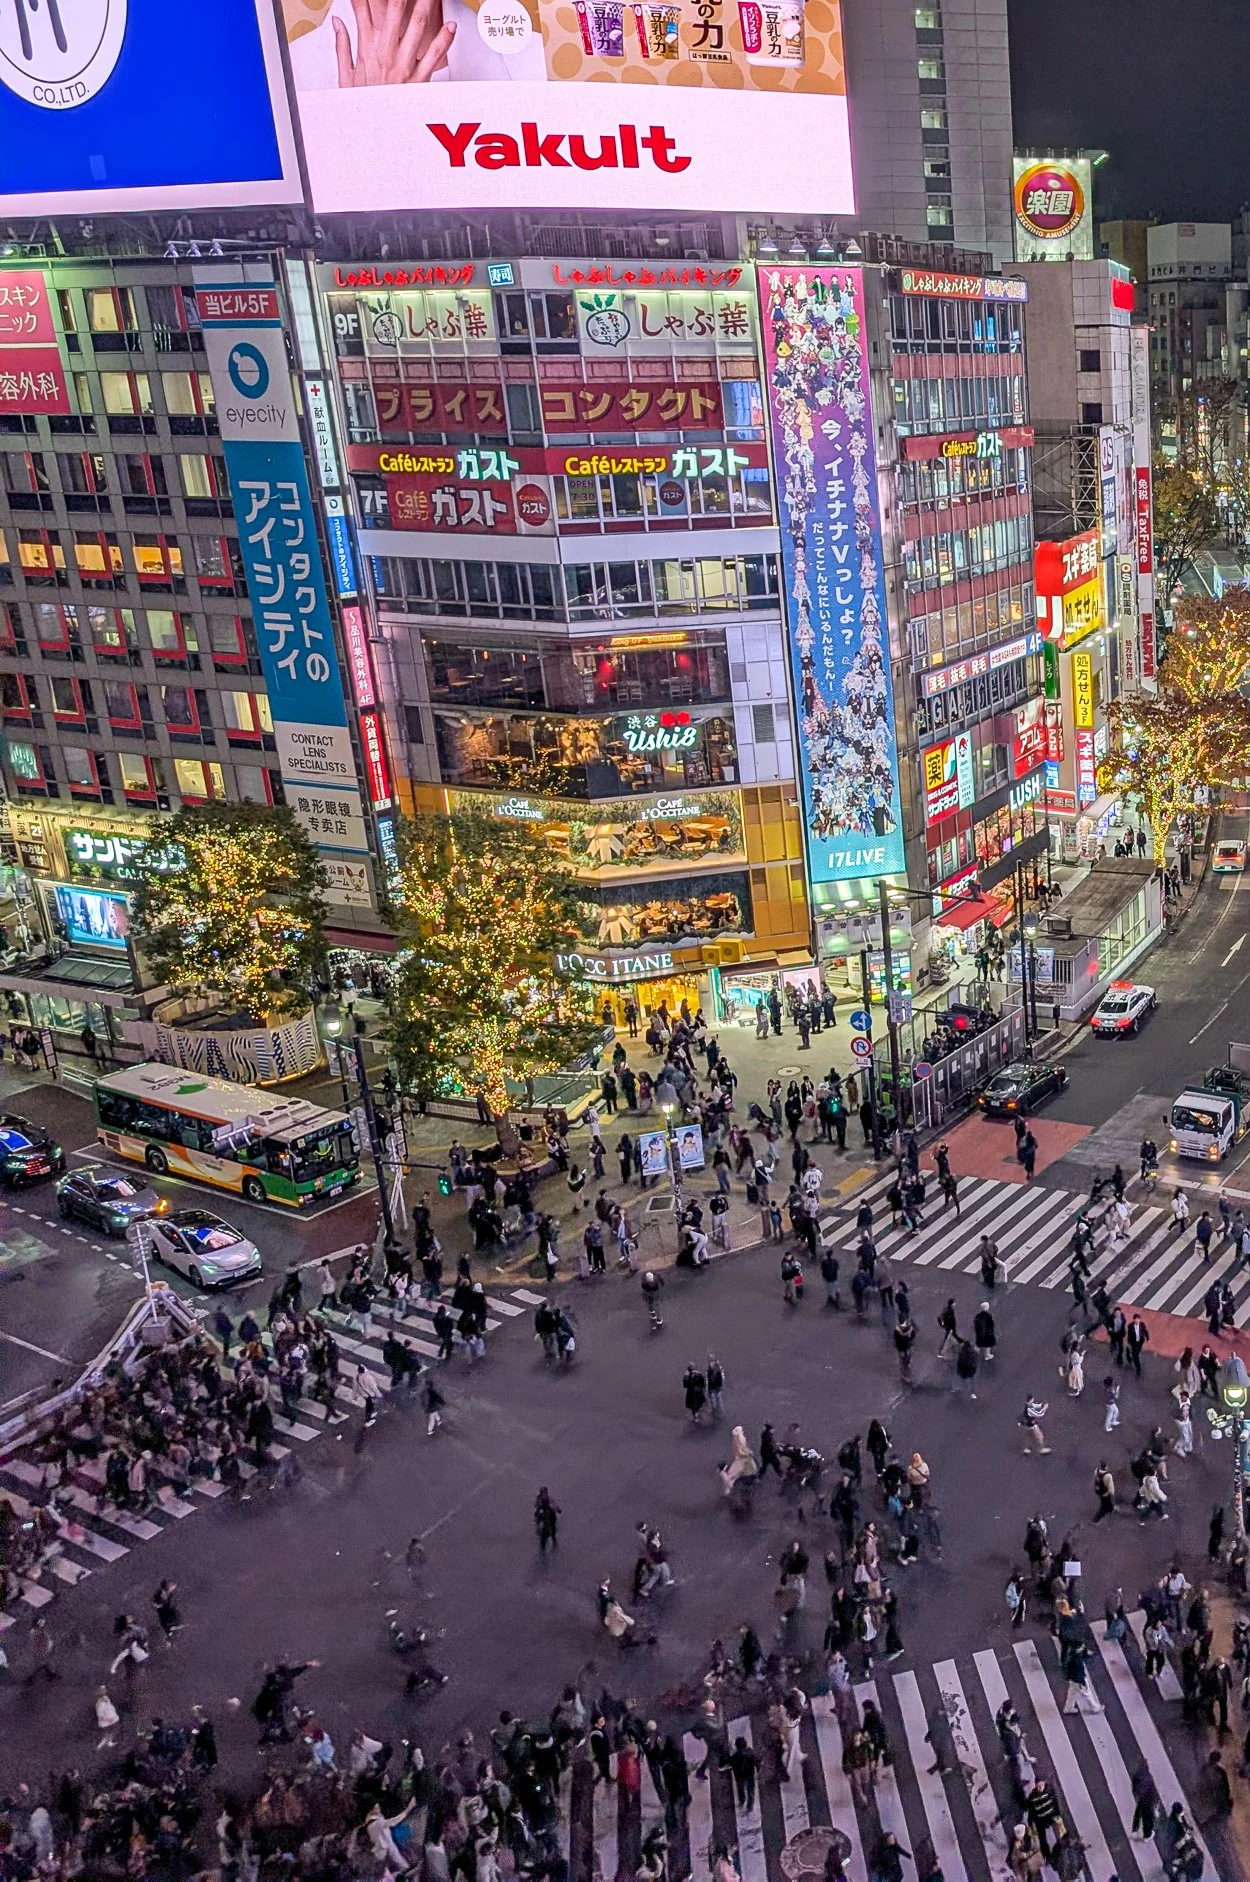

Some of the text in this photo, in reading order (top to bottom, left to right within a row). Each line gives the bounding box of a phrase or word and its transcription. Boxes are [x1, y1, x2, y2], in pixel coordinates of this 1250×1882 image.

[483, 14, 526, 25] ヨーグルト
[487, 26, 525, 37] 売り場で
[593, 6, 610, 51] 豆乳の力
[650, 10, 666, 54] 豆乳の力
[690, 0, 724, 49] の力
[765, 11, 782, 55] 豆乳の力
[426, 121, 693, 174] Yakult
[1026, 189, 1075, 216] 楽園
[1017, 212, 1083, 240] EXCITING AMUSEMENT
[553, 263, 744, 288] しゃぶしゃぶバイキング
[205, 293, 270, 316] 当ビル5F
[334, 313, 359, 337] 9F
[406, 303, 489, 339] しゃぶ葉
[641, 300, 750, 338] しゃぶ葉
[225, 403, 287, 430] eyecity
[376, 388, 505, 424] プライス
[543, 387, 719, 426] コンタクト
[312, 405, 335, 475] 献血ルーム
[975, 432, 1003, 459] ガスト
[458, 449, 521, 481] ガスト
[671, 447, 750, 478] ガスト
[569, 479, 595, 489] OPEN
[662, 490, 683, 500] ガスト
[360, 490, 388, 514] 7F
[395, 490, 429, 509] Café
[431, 486, 508, 528] ガスト
[521, 501, 547, 515] ガスト
[398, 509, 429, 521] レストラン
[1138, 510, 1150, 564] TaxFree
[1062, 539, 1098, 585] スギ薬局
[1121, 563, 1132, 582] OS
[238, 480, 331, 682] コンタクトの アイシティ
[1029, 631, 1042, 652] 4F
[950, 664, 967, 685] 抜毛
[971, 656, 987, 677] 発毛
[1076, 655, 1091, 705] 処方せん
[359, 694, 372, 704] 4F
[627, 715, 658, 729] 渋谷
[291, 732, 334, 747] CONTACT
[303, 746, 327, 759] LENS
[1019, 727, 1041, 754] アコム
[288, 757, 348, 774] SPECIALISTS
[926, 753, 943, 786] 薬
[1078, 731, 1094, 784] スギ薬局
[926, 790, 959, 817] サンドラッグ
[1009, 773, 1041, 812] LUSH
[297, 797, 352, 818] 隐形眼镜
[308, 816, 348, 836] 专卖店
[828, 847, 886, 870] 17LIVE
